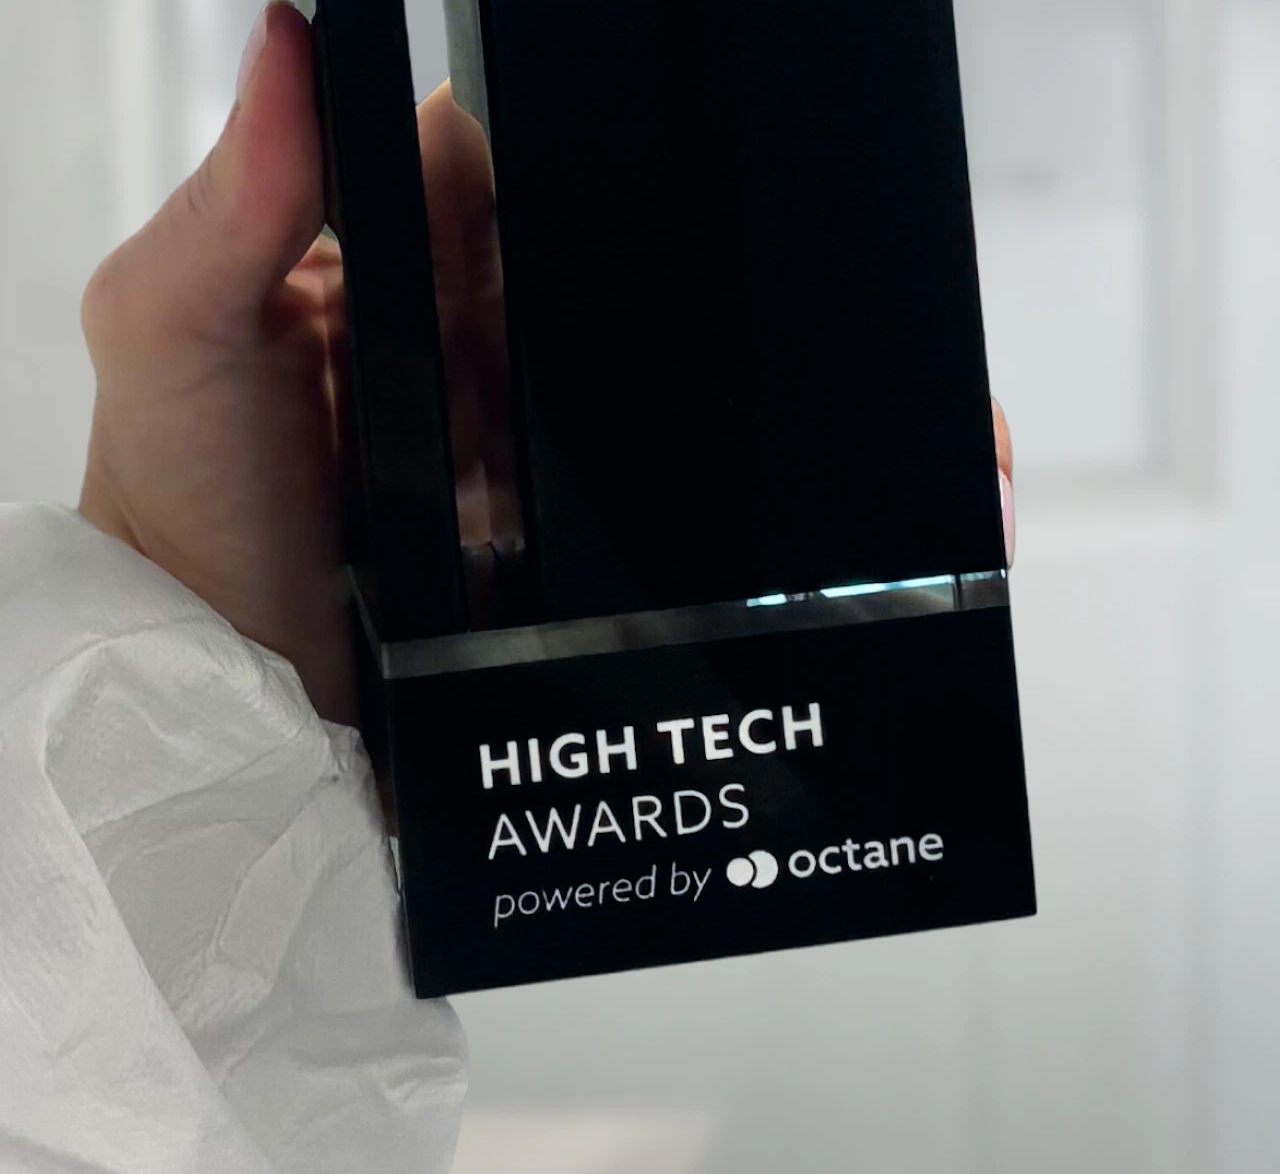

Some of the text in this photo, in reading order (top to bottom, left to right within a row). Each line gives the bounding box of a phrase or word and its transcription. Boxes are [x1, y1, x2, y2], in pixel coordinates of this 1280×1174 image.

[479, 702, 823, 789] HIGH TECH
[488, 783, 749, 860] AWARDS
[492, 833, 944, 929] powered by octane
